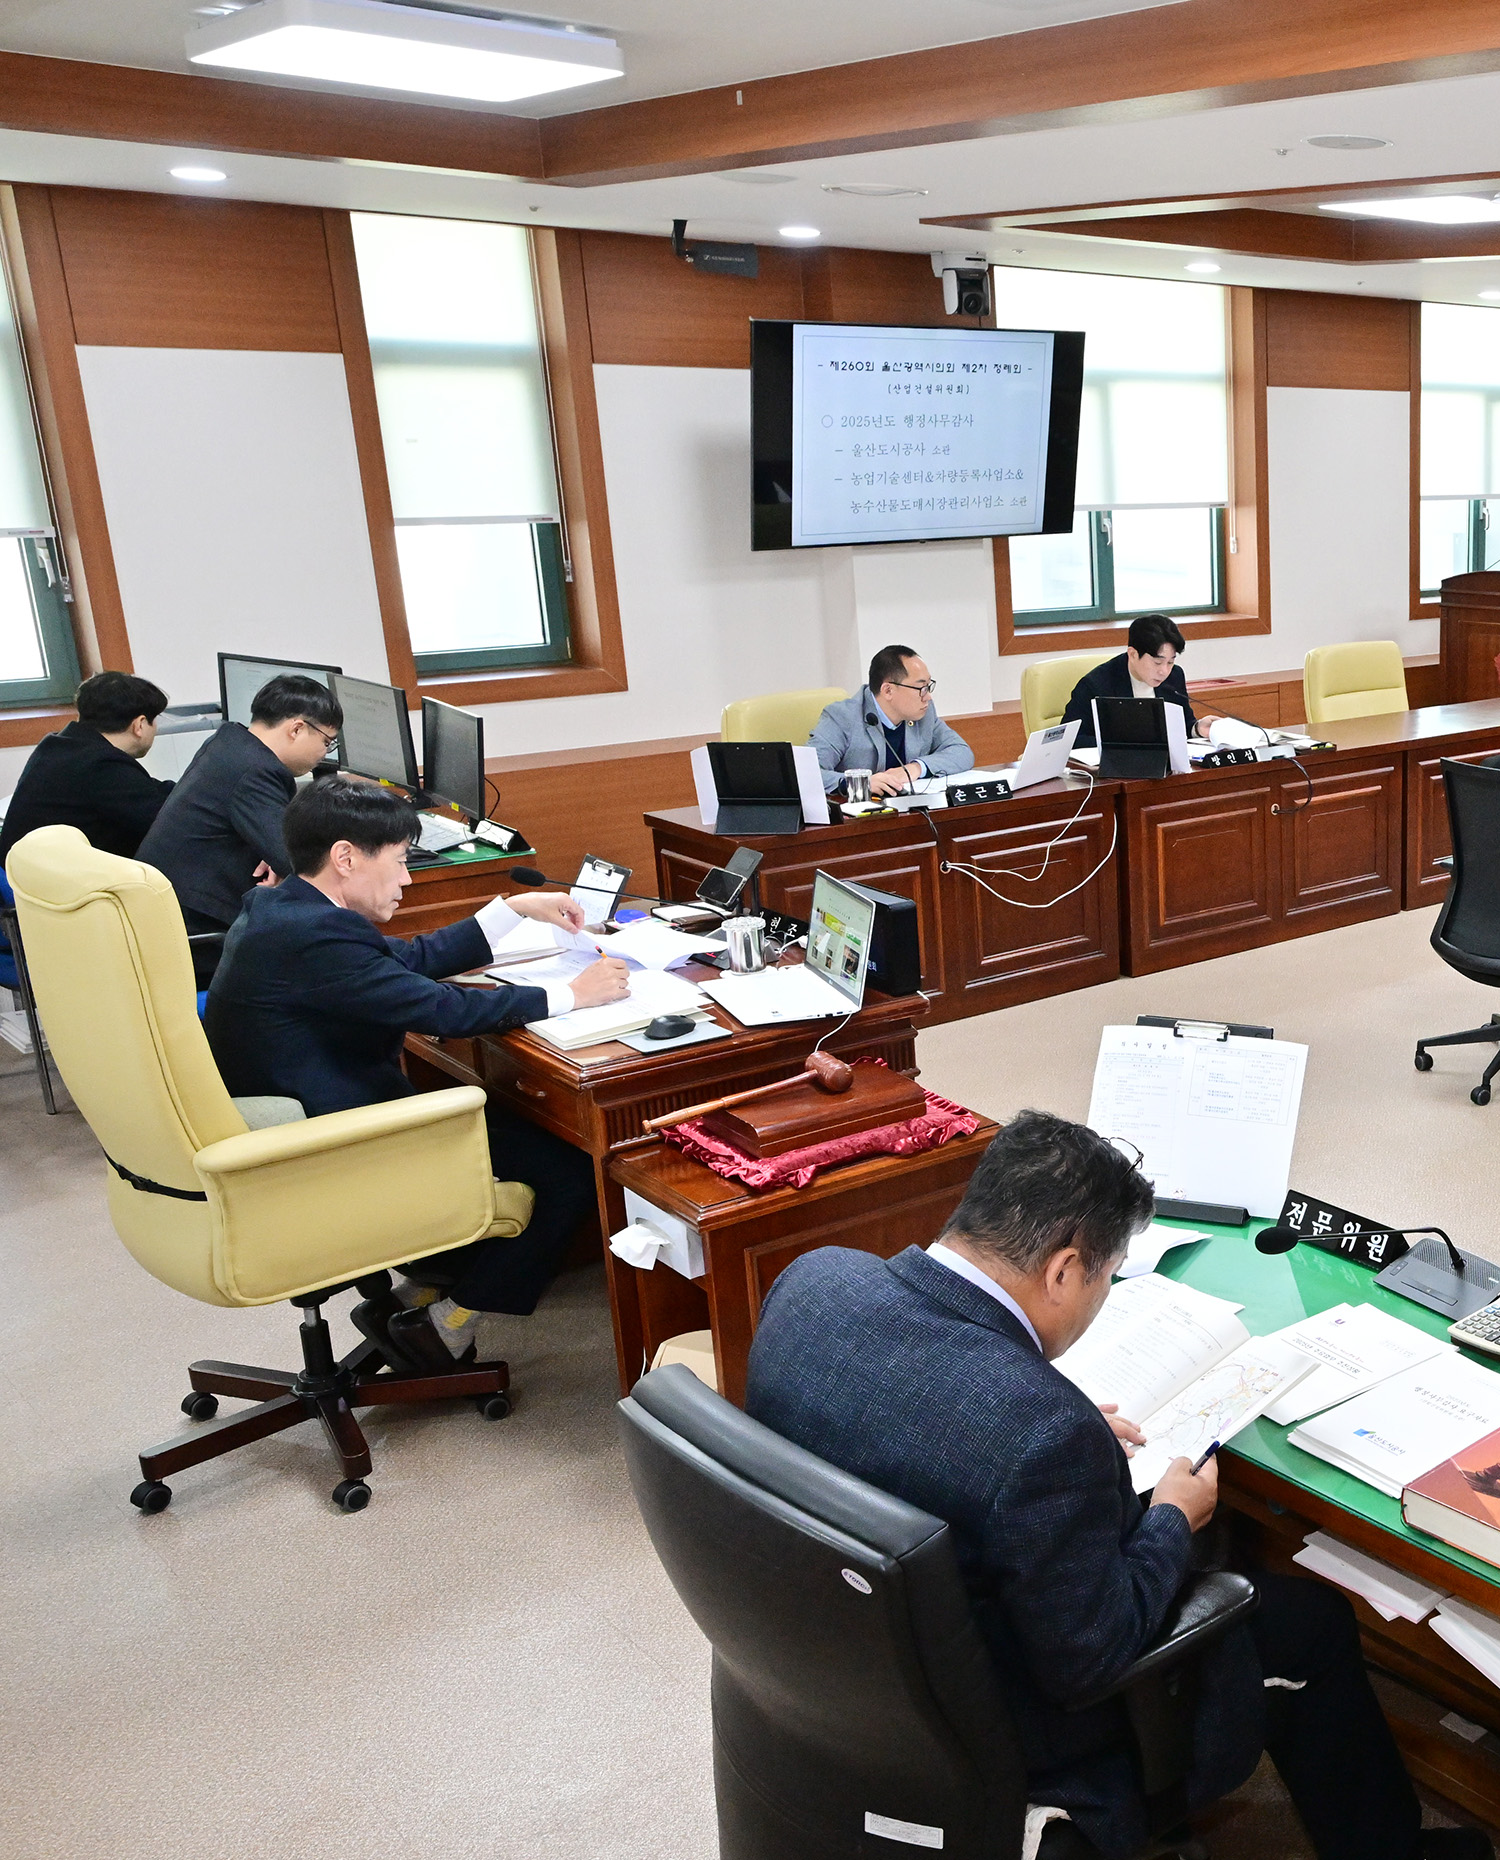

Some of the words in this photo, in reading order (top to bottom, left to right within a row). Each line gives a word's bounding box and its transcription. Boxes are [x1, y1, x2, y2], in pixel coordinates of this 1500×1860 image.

[829, 361, 875, 372] 제260회
[882, 361, 955, 373] 울산광역시의회
[961, 363, 988, 374] 제2차
[993, 363, 1022, 374] 정례회
[887, 383, 970, 395] (산업건설위원회)
[841, 414, 896, 429] 2025년도
[903, 413, 975, 429] 행정사무감사
[851, 442, 926, 458] 울산도시공사
[932, 444, 950, 456] 소관
[851, 468, 1024, 486] 농업기술센터&차량등록사업소&
[850, 495, 1004, 514] 농수산물도매시장관리사업소
[1009, 495, 1027, 507] 소관
[1211, 750, 1254, 766] 방인섭
[954, 783, 1008, 802] 손근호
[1286, 1201, 1389, 1263] 전문위원
